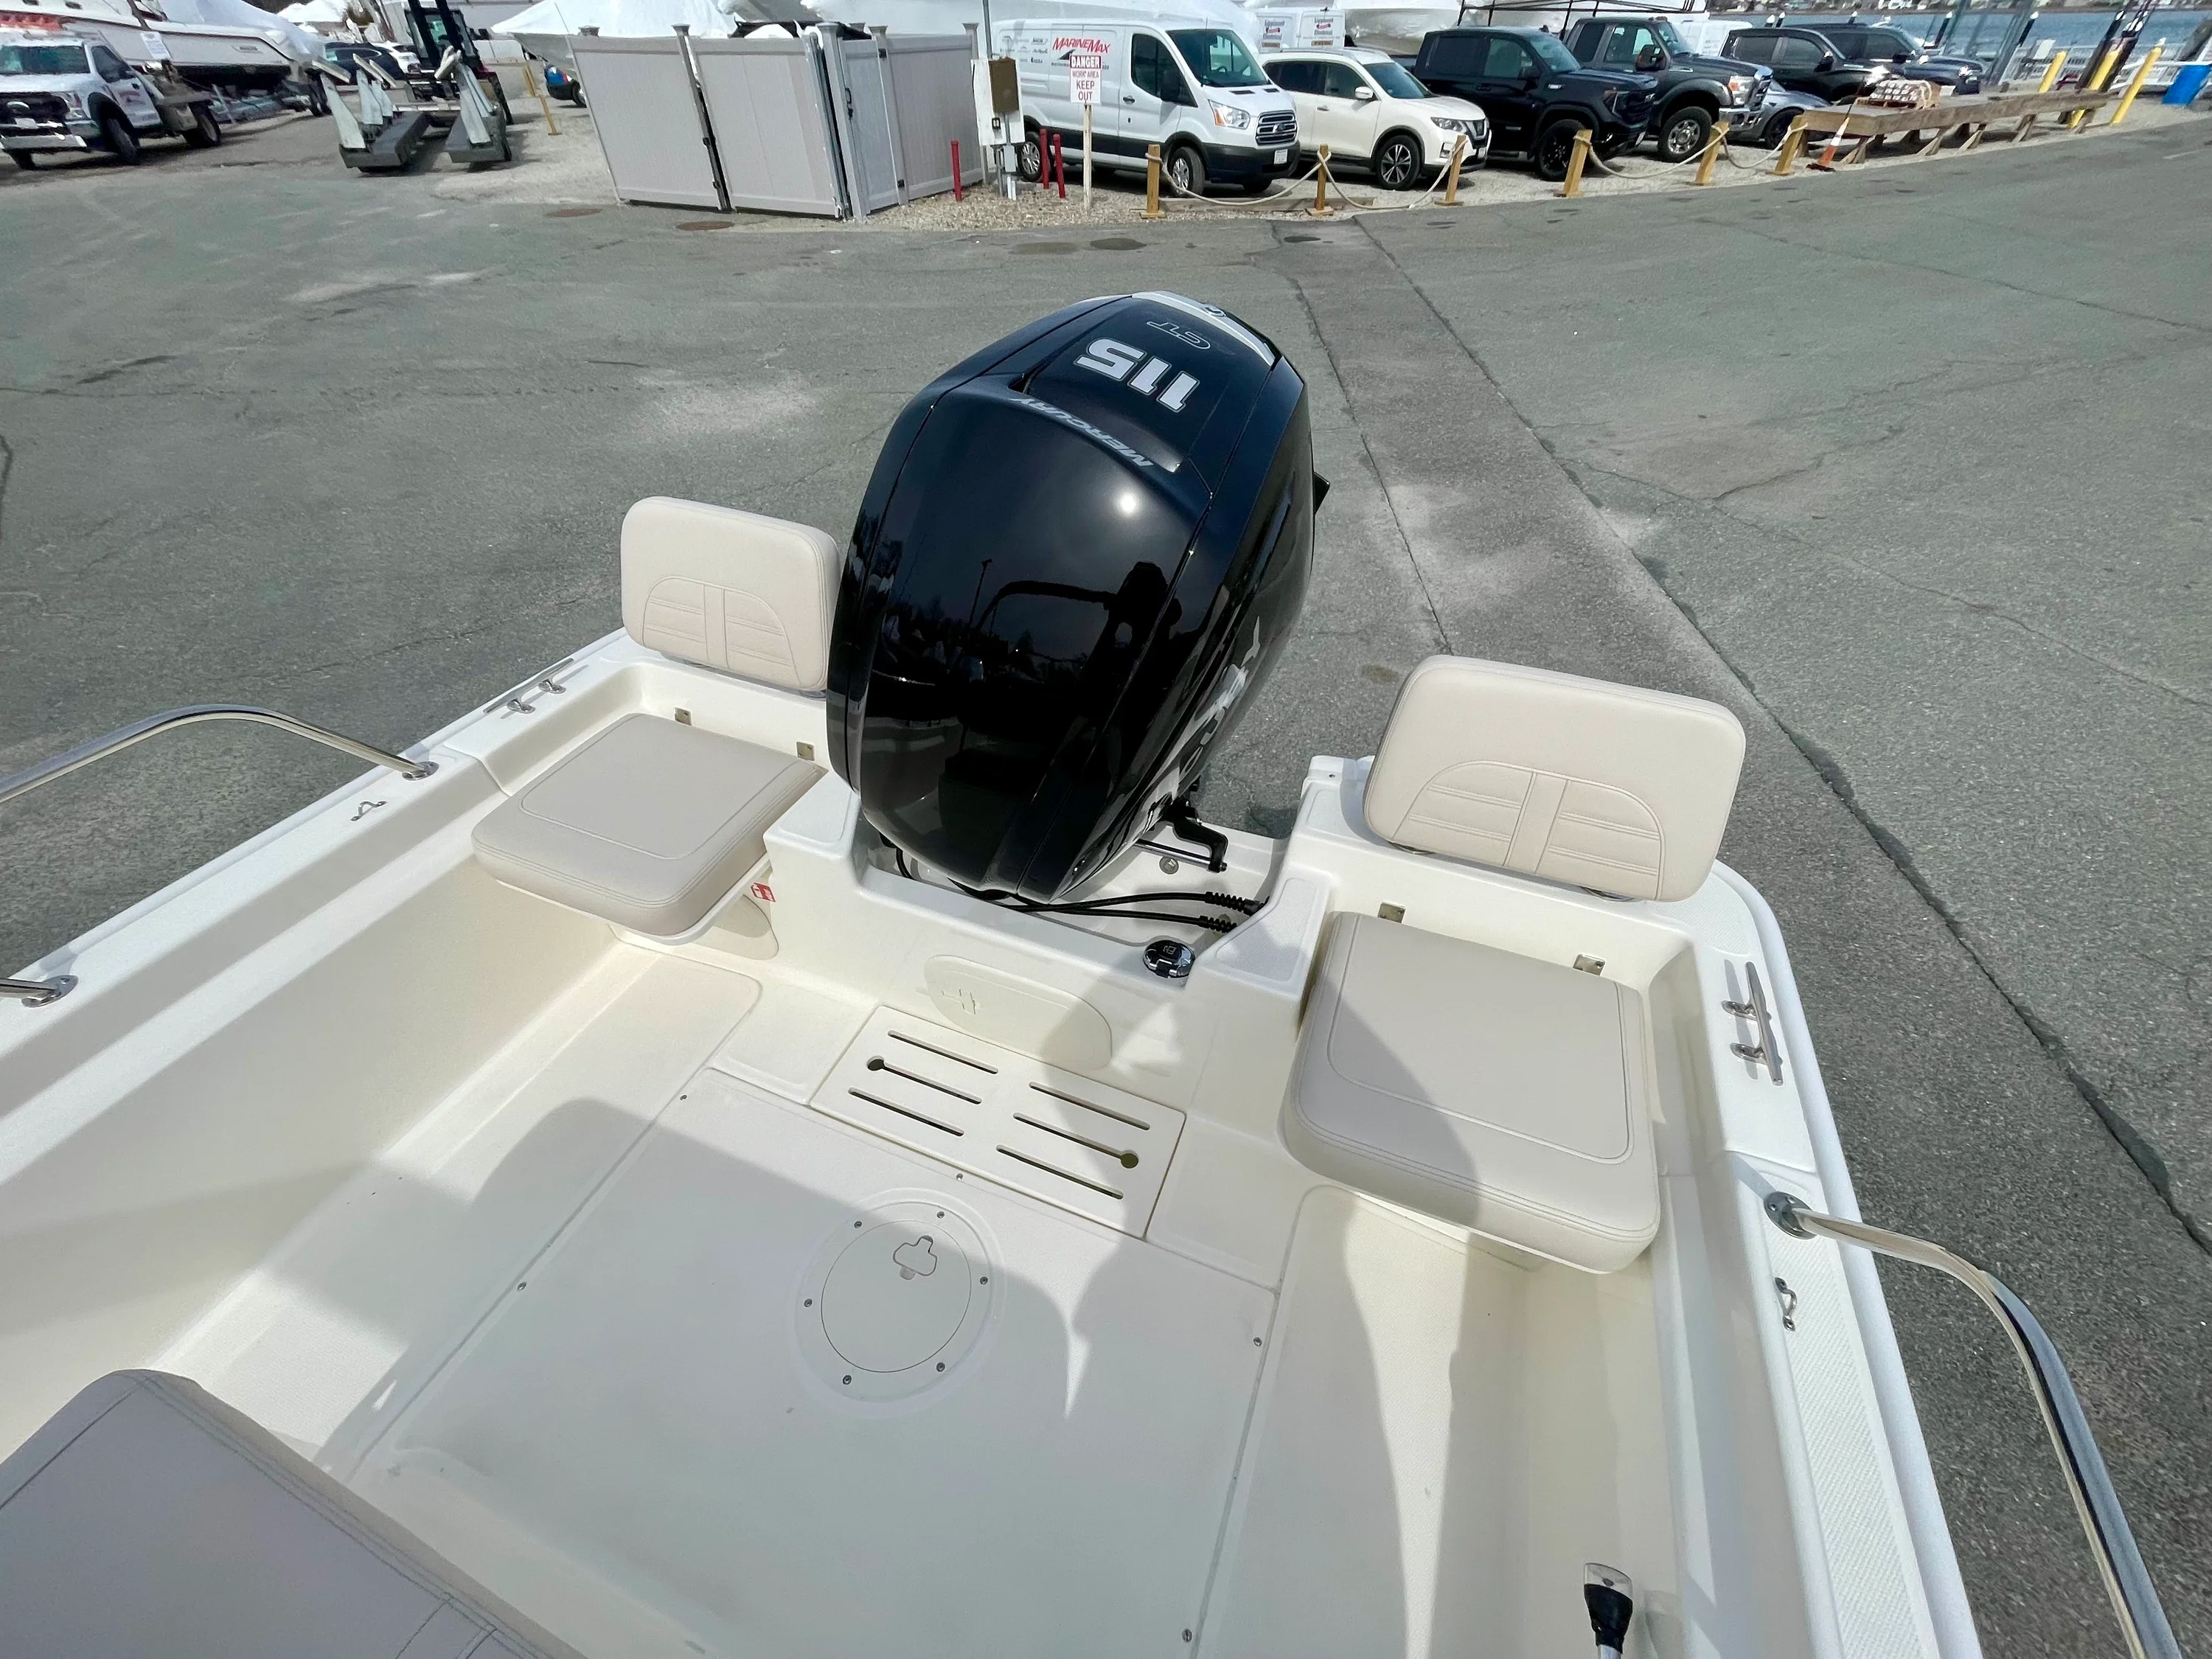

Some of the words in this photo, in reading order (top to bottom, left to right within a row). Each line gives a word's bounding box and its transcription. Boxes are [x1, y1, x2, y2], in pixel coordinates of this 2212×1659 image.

[1071, 55, 1100, 69] DANGER
[1072, 70, 1086, 78] WORK
[1077, 80, 1095, 89] KEEP
[1078, 91, 1093, 101] OUT
[1074, 338, 1200, 413] 115
[1007, 397, 1154, 467] MERCURY
